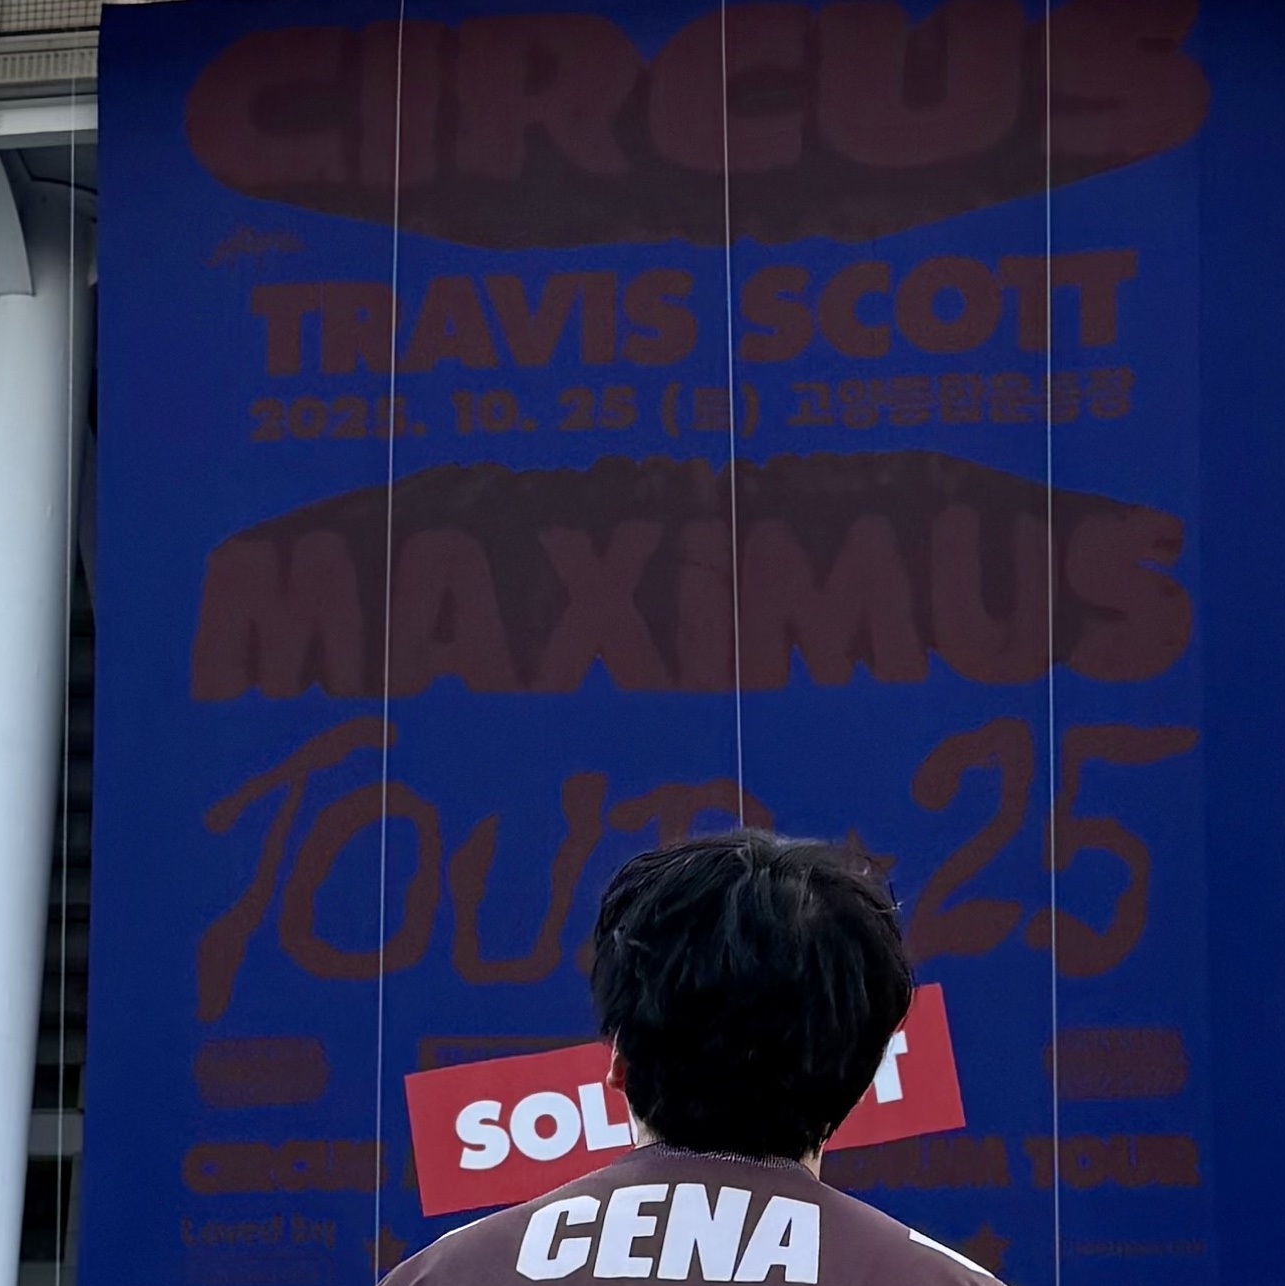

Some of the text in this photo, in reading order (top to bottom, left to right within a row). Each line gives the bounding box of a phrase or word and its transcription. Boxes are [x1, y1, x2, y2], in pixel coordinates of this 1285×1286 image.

[253, 245, 1138, 380] TRAVIS SCOTT
[561, 387, 637, 431] 25
[192, 508, 1196, 702] MAXIMUS
[455, 1083, 637, 1171] SOL
[517, 1185, 820, 1284] CENA
